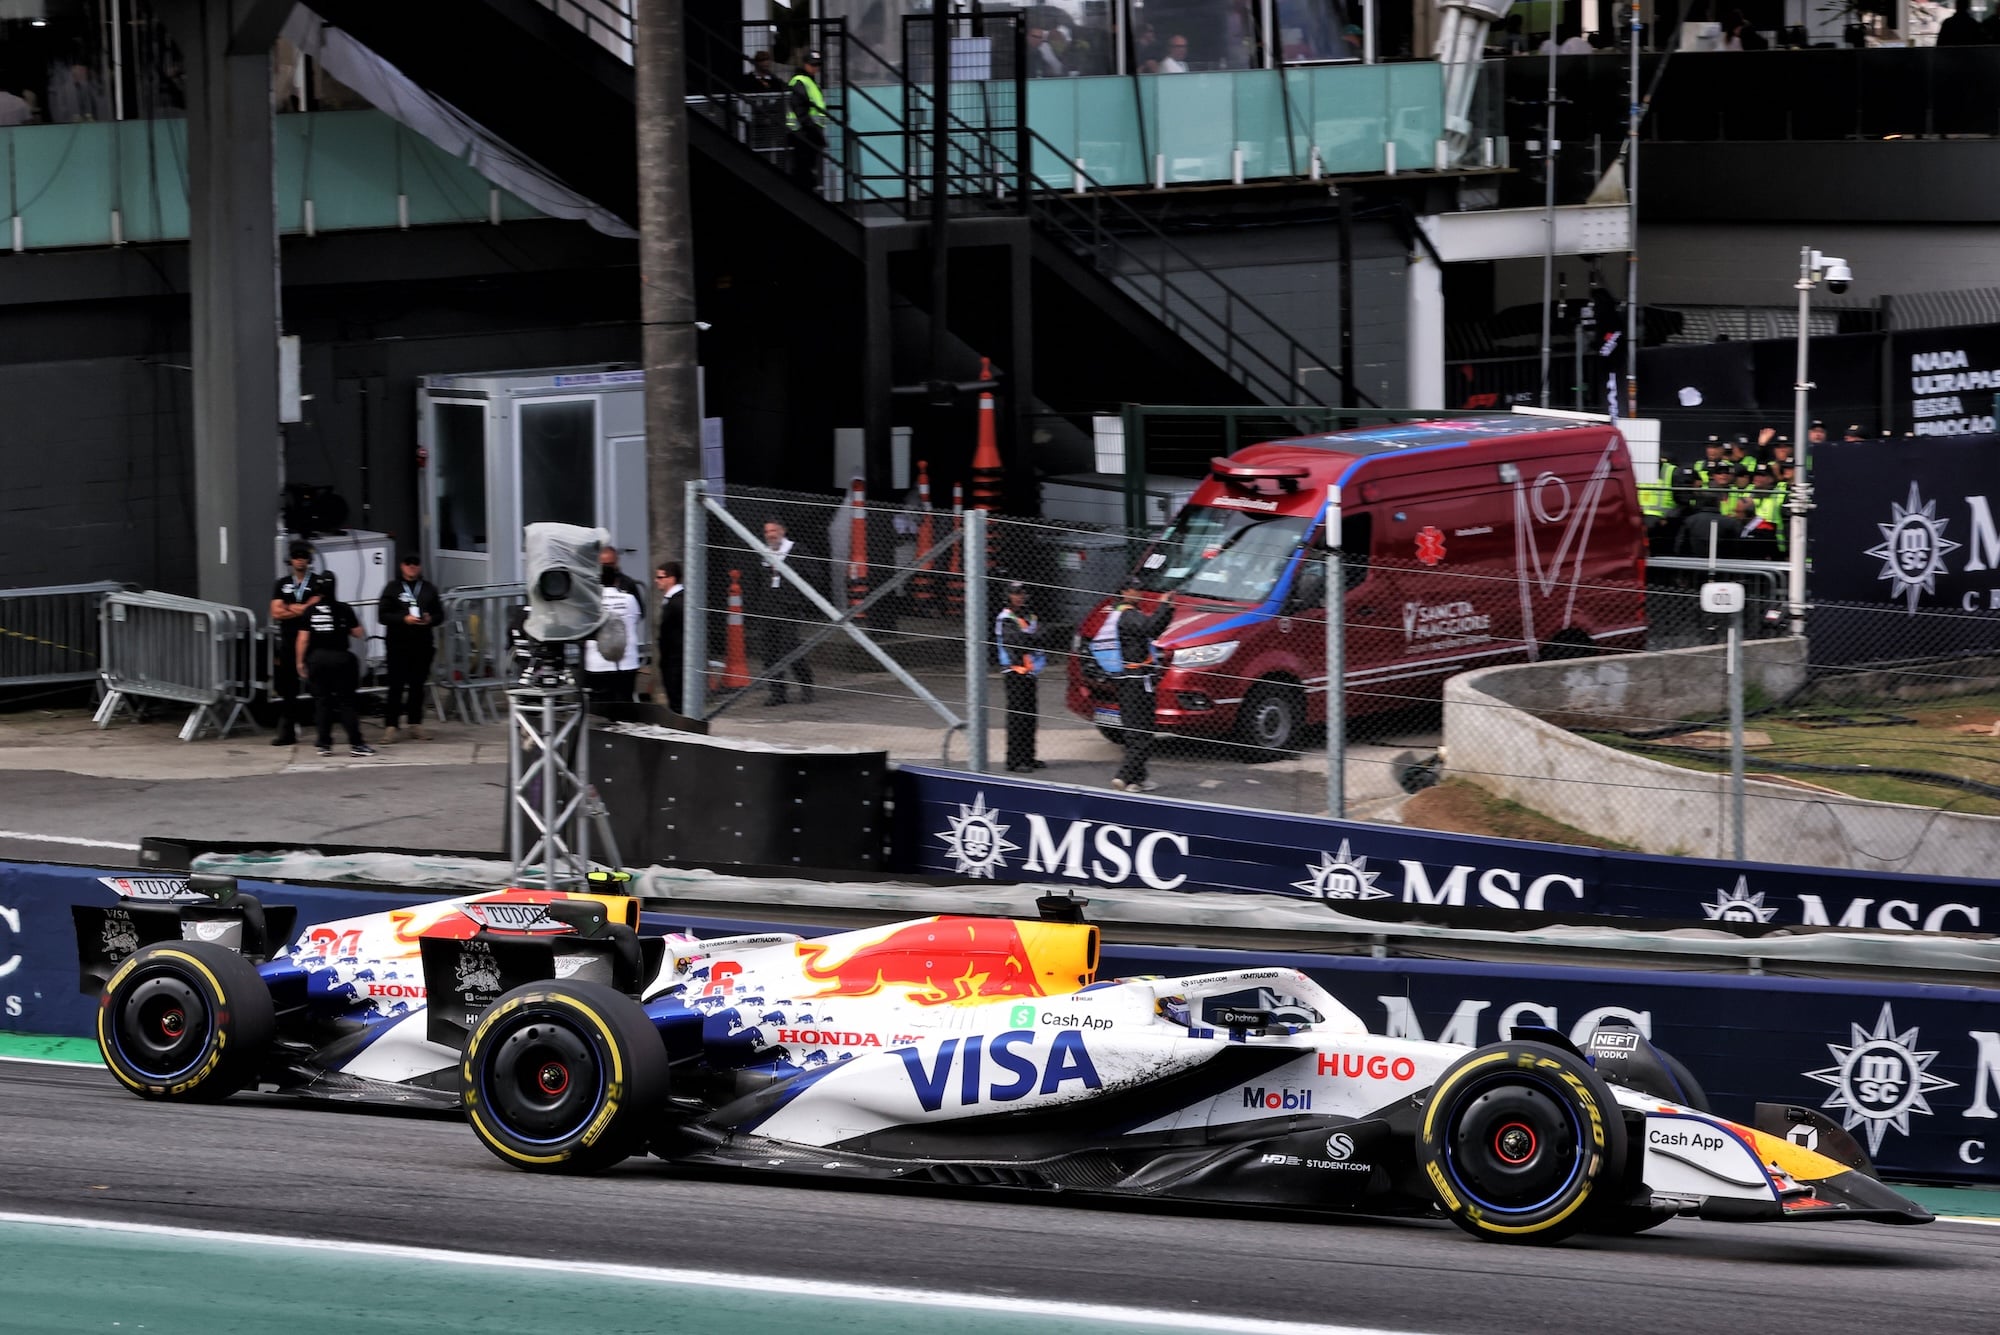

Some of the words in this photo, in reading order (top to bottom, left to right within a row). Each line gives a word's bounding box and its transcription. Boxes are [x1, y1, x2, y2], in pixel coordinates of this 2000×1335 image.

[1911, 350, 1969, 372] NADA
[1912, 396, 1964, 418] ESSA
[1021, 813, 1189, 890] MSC
[1398, 859, 1584, 911] MSC
[104, 909, 130, 920] VISA
[486, 905, 554, 925] TUDOR
[460, 940, 491, 953] VISA
[1041, 1012, 1079, 1027] Cash
[1082, 1015, 1114, 1031] App
[777, 1029, 882, 1047] HONDA
[1597, 1033, 1633, 1046] NEFT
[1598, 1050, 1629, 1060] VODKA
[883, 1030, 1103, 1113] VISA
[1317, 1053, 1415, 1081] HUGO
[1243, 1087, 1312, 1110] Mobil
[1649, 1130, 1688, 1146] Cash
[1692, 1133, 1724, 1151] App
[1306, 1159, 1371, 1172] STUDENT.COM
